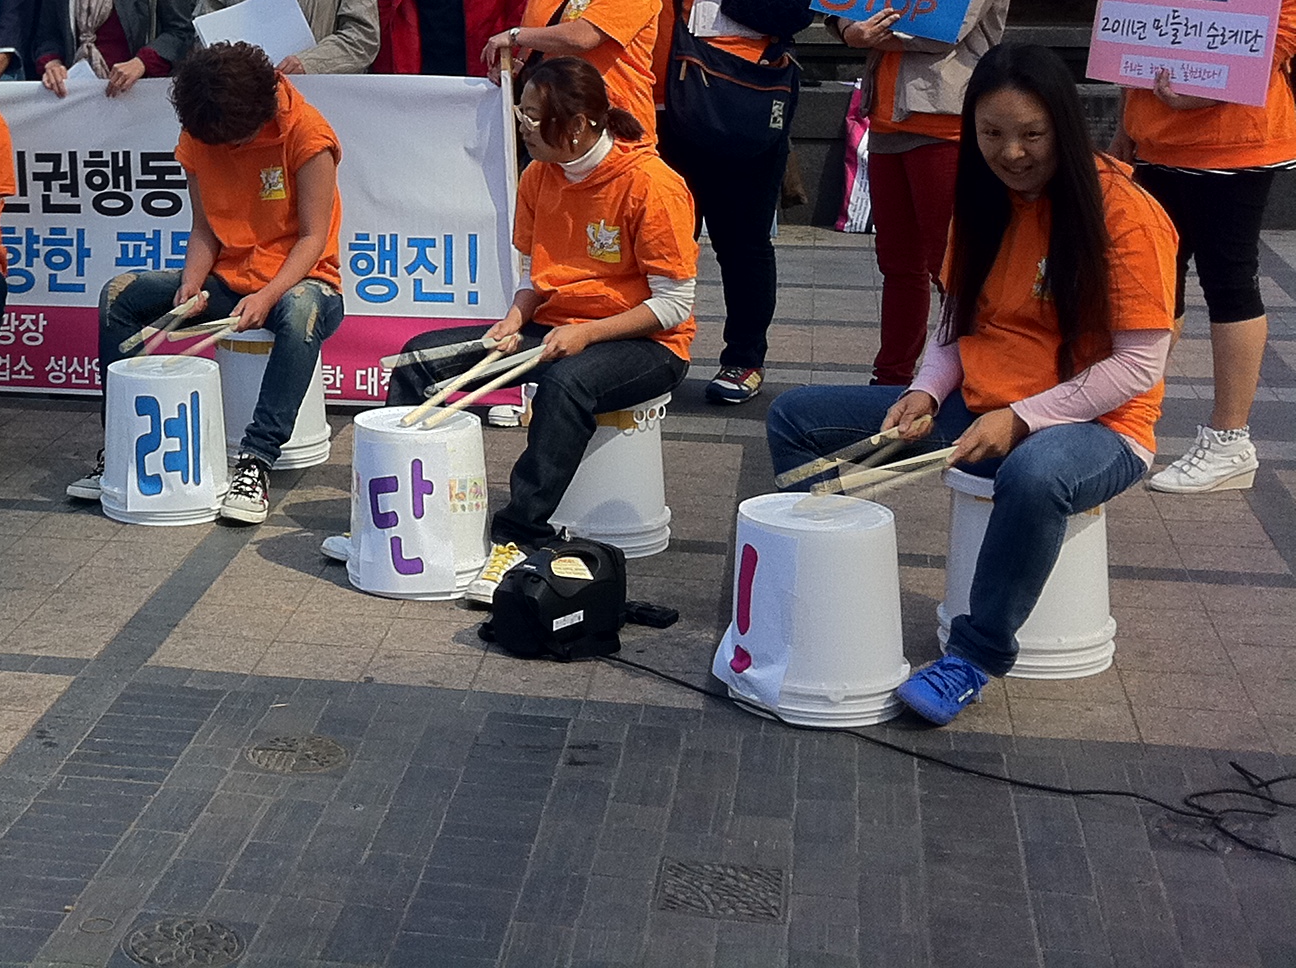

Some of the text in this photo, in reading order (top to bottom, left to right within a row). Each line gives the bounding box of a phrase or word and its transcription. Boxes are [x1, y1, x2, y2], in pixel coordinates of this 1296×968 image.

[1102, 9, 1264, 53] 2011년 민들레 순례단
[347, 232, 480, 305] 행진!
[135, 390, 202, 497] 례
[368, 458, 435, 576] 단
[730, 542, 759, 674] !
